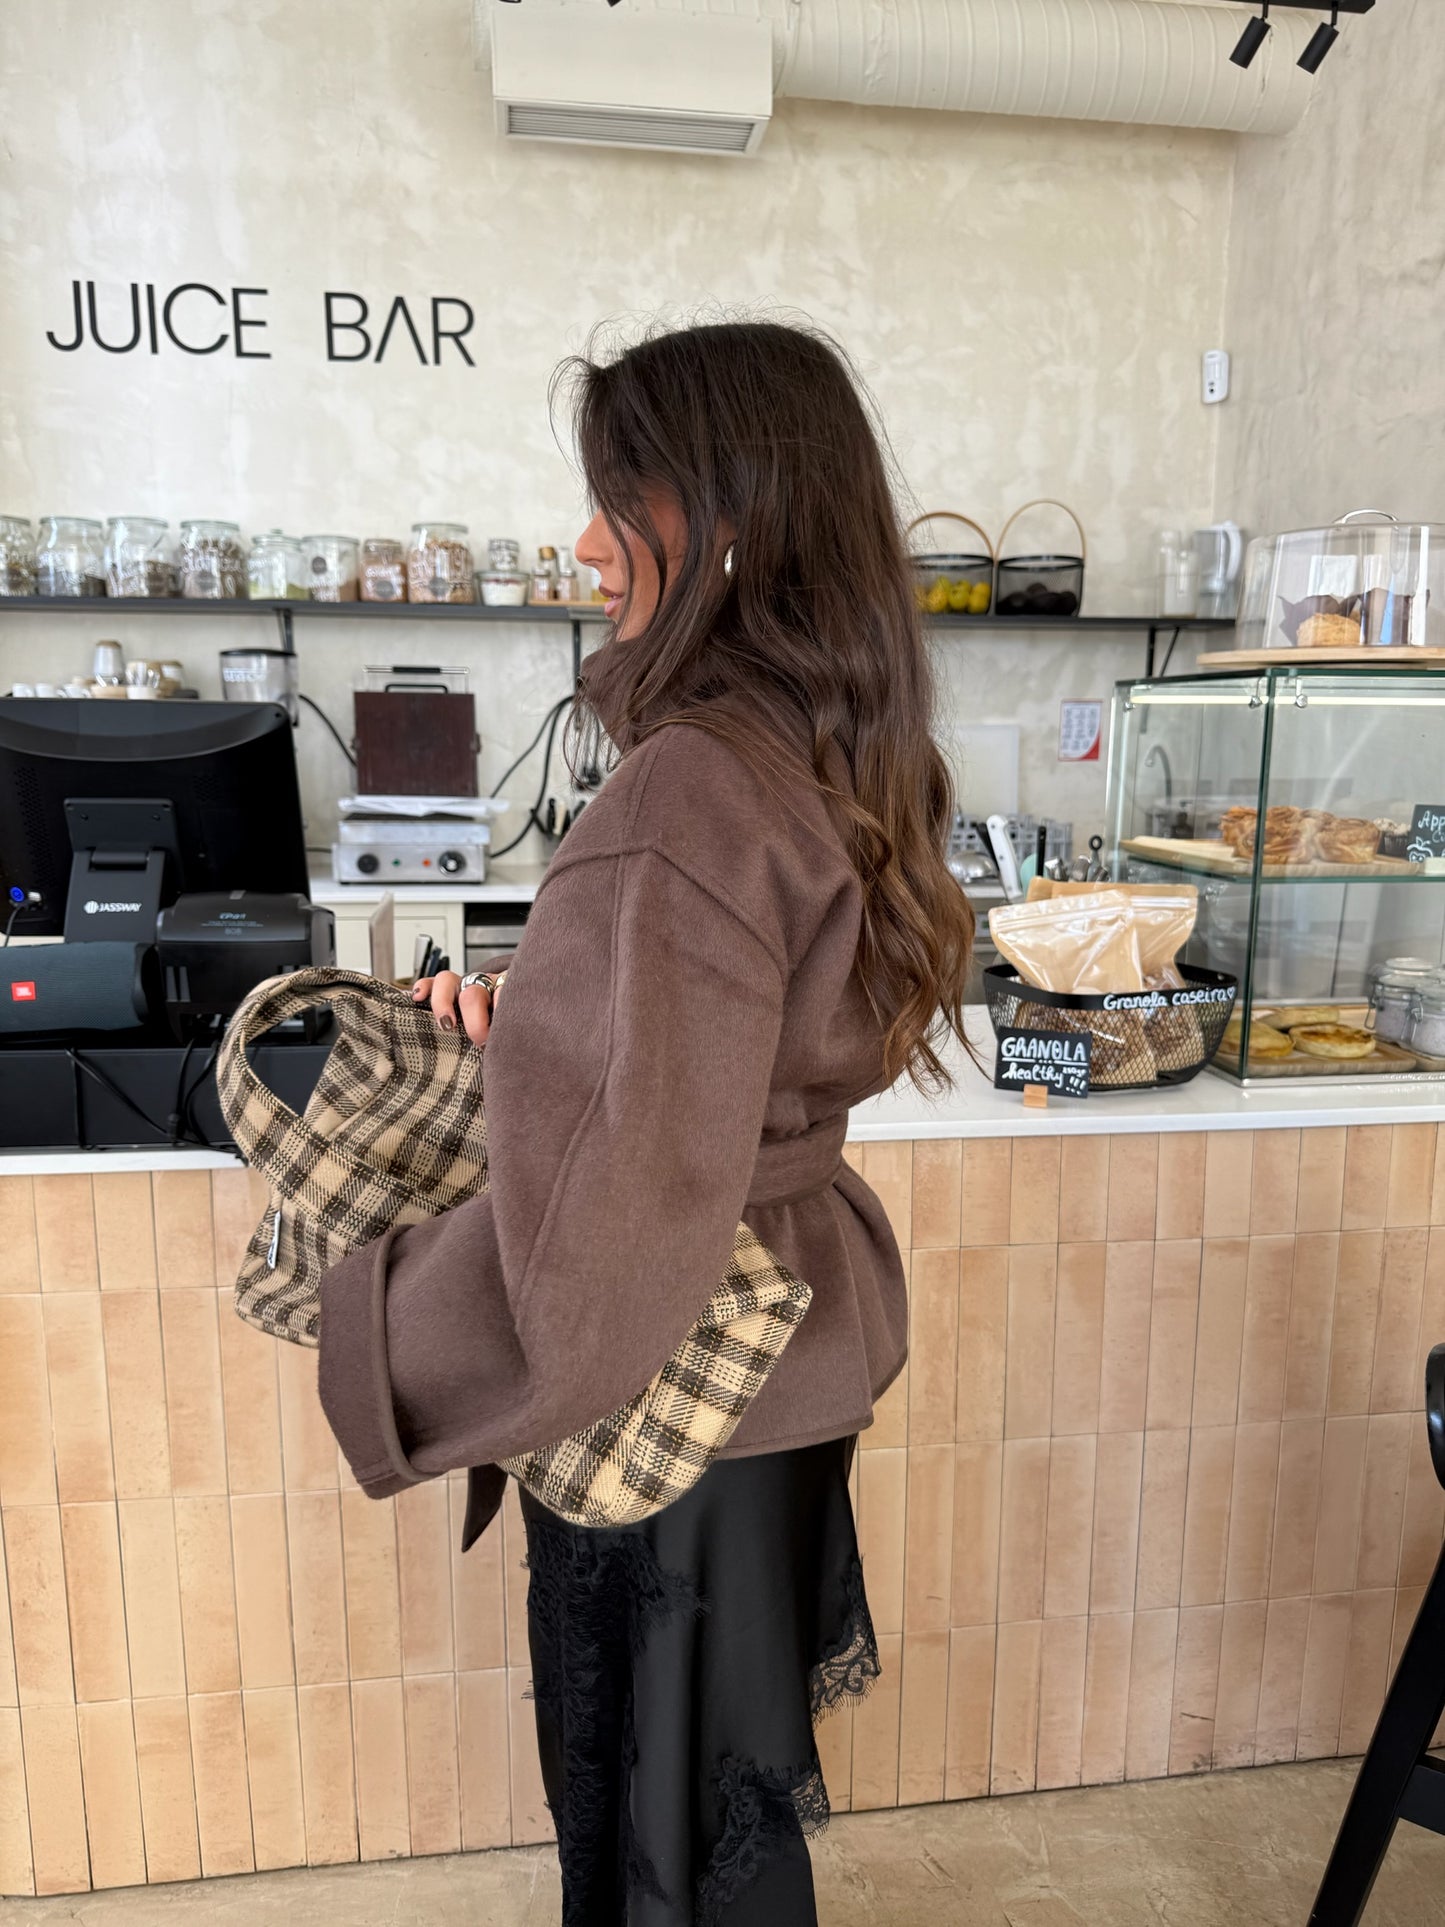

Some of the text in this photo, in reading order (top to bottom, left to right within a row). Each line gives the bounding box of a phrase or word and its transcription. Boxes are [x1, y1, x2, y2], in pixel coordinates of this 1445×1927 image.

[46, 280, 476, 367] JUICE BAR
[99, 902, 142, 913] JASSWAY
[1103, 987, 1228, 1010] Granola caseira
[1001, 1036, 1087, 1061] GRANOLA
[1002, 1062, 1064, 1088] healthy
